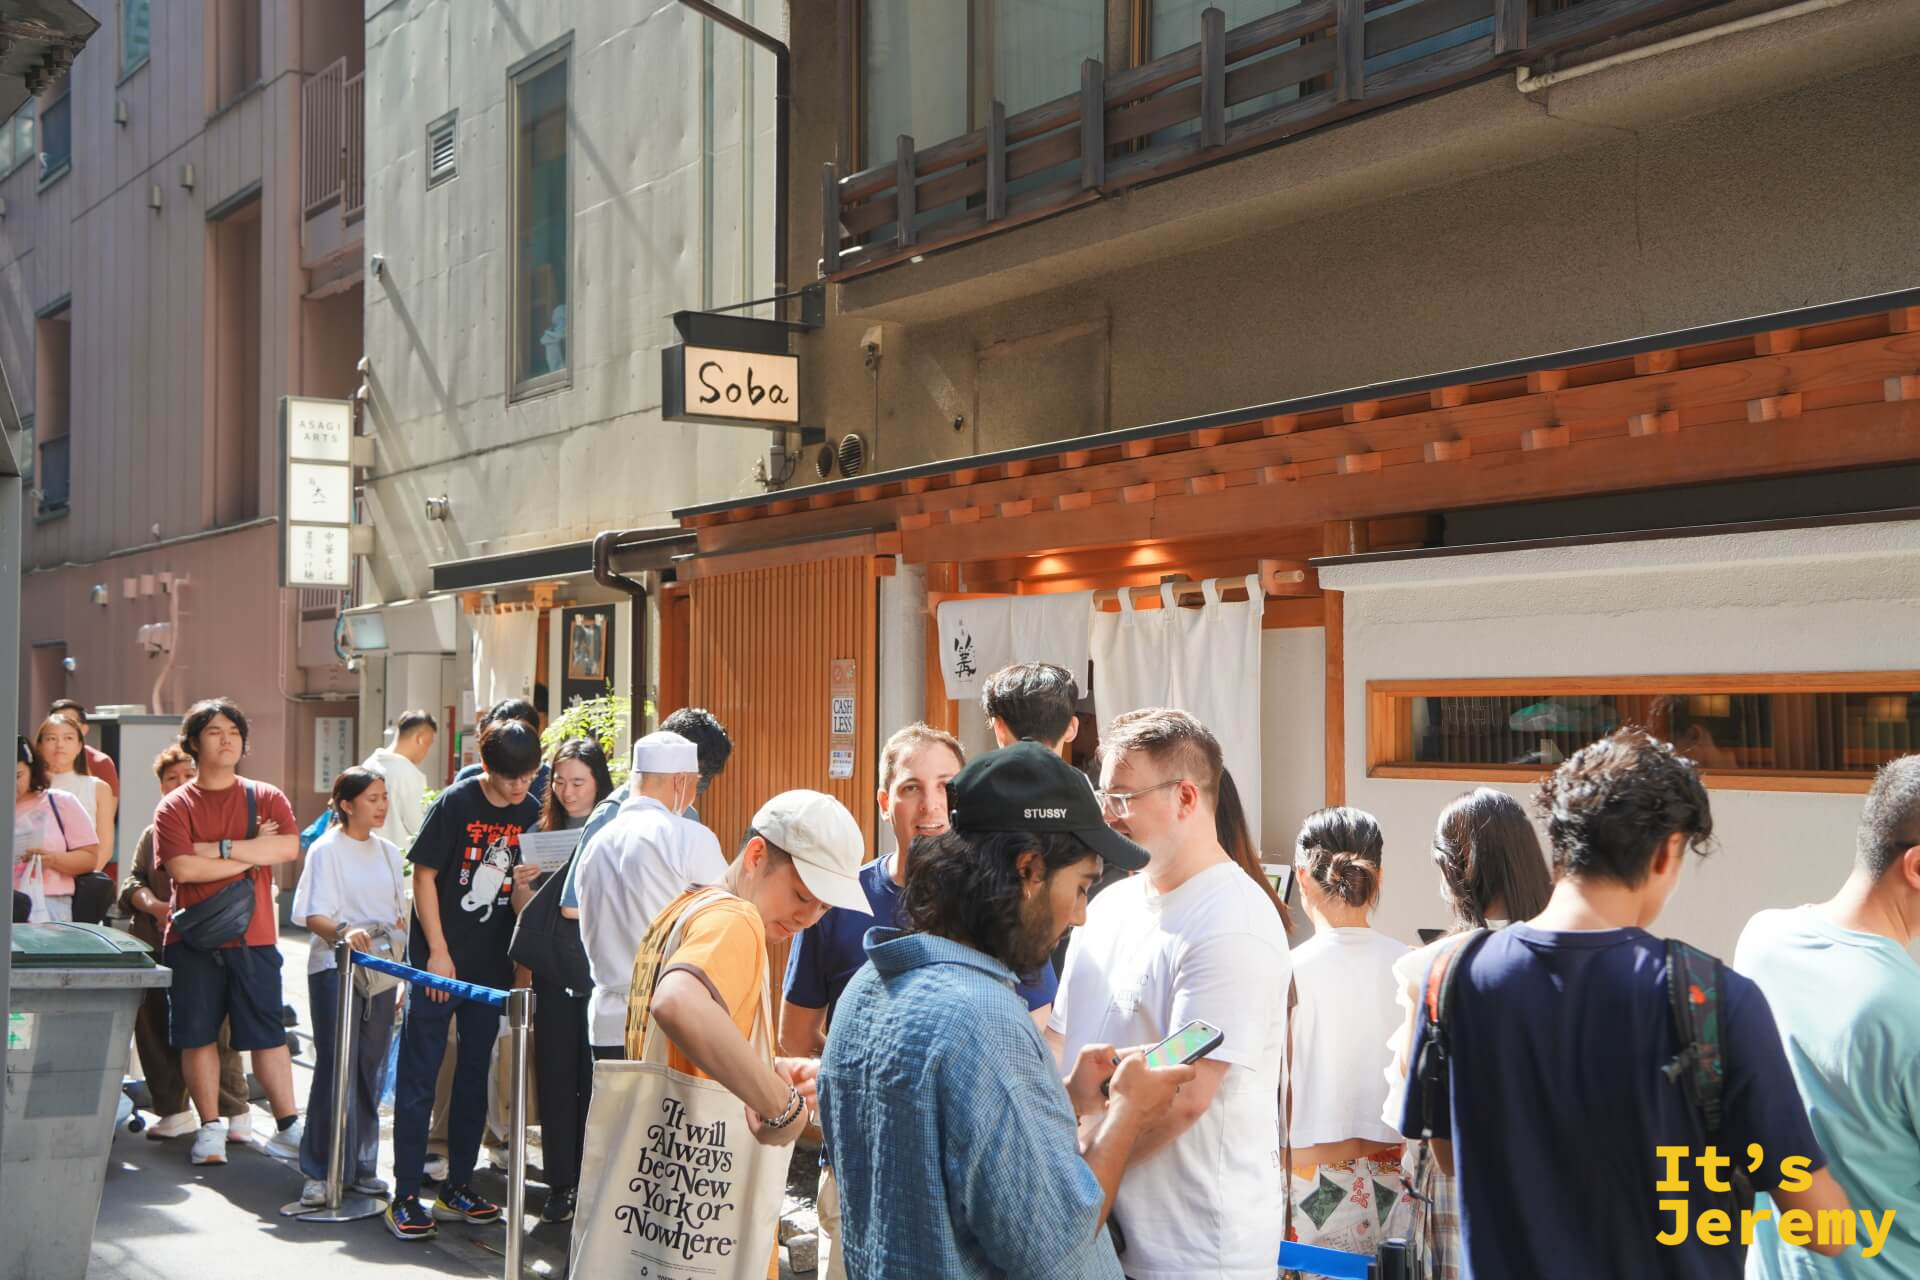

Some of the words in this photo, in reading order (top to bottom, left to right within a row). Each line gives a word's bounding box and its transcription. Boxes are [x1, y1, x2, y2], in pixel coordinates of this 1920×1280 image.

[699, 361, 789, 405] Soba
[299, 419, 341, 432] ASAGI
[303, 432, 338, 443] ARTS
[833, 699, 853, 714] CASH
[833, 716, 853, 733] LESS
[1023, 808, 1067, 819] STUSSY
[662, 1097, 687, 1130] It
[686, 1120, 726, 1147] will
[647, 1124, 733, 1173] Always
[638, 1147, 665, 1179] be
[664, 1162, 732, 1199] New
[628, 1177, 704, 1229] York
[697, 1202, 734, 1221] or
[614, 1205, 732, 1260] Nowhere
